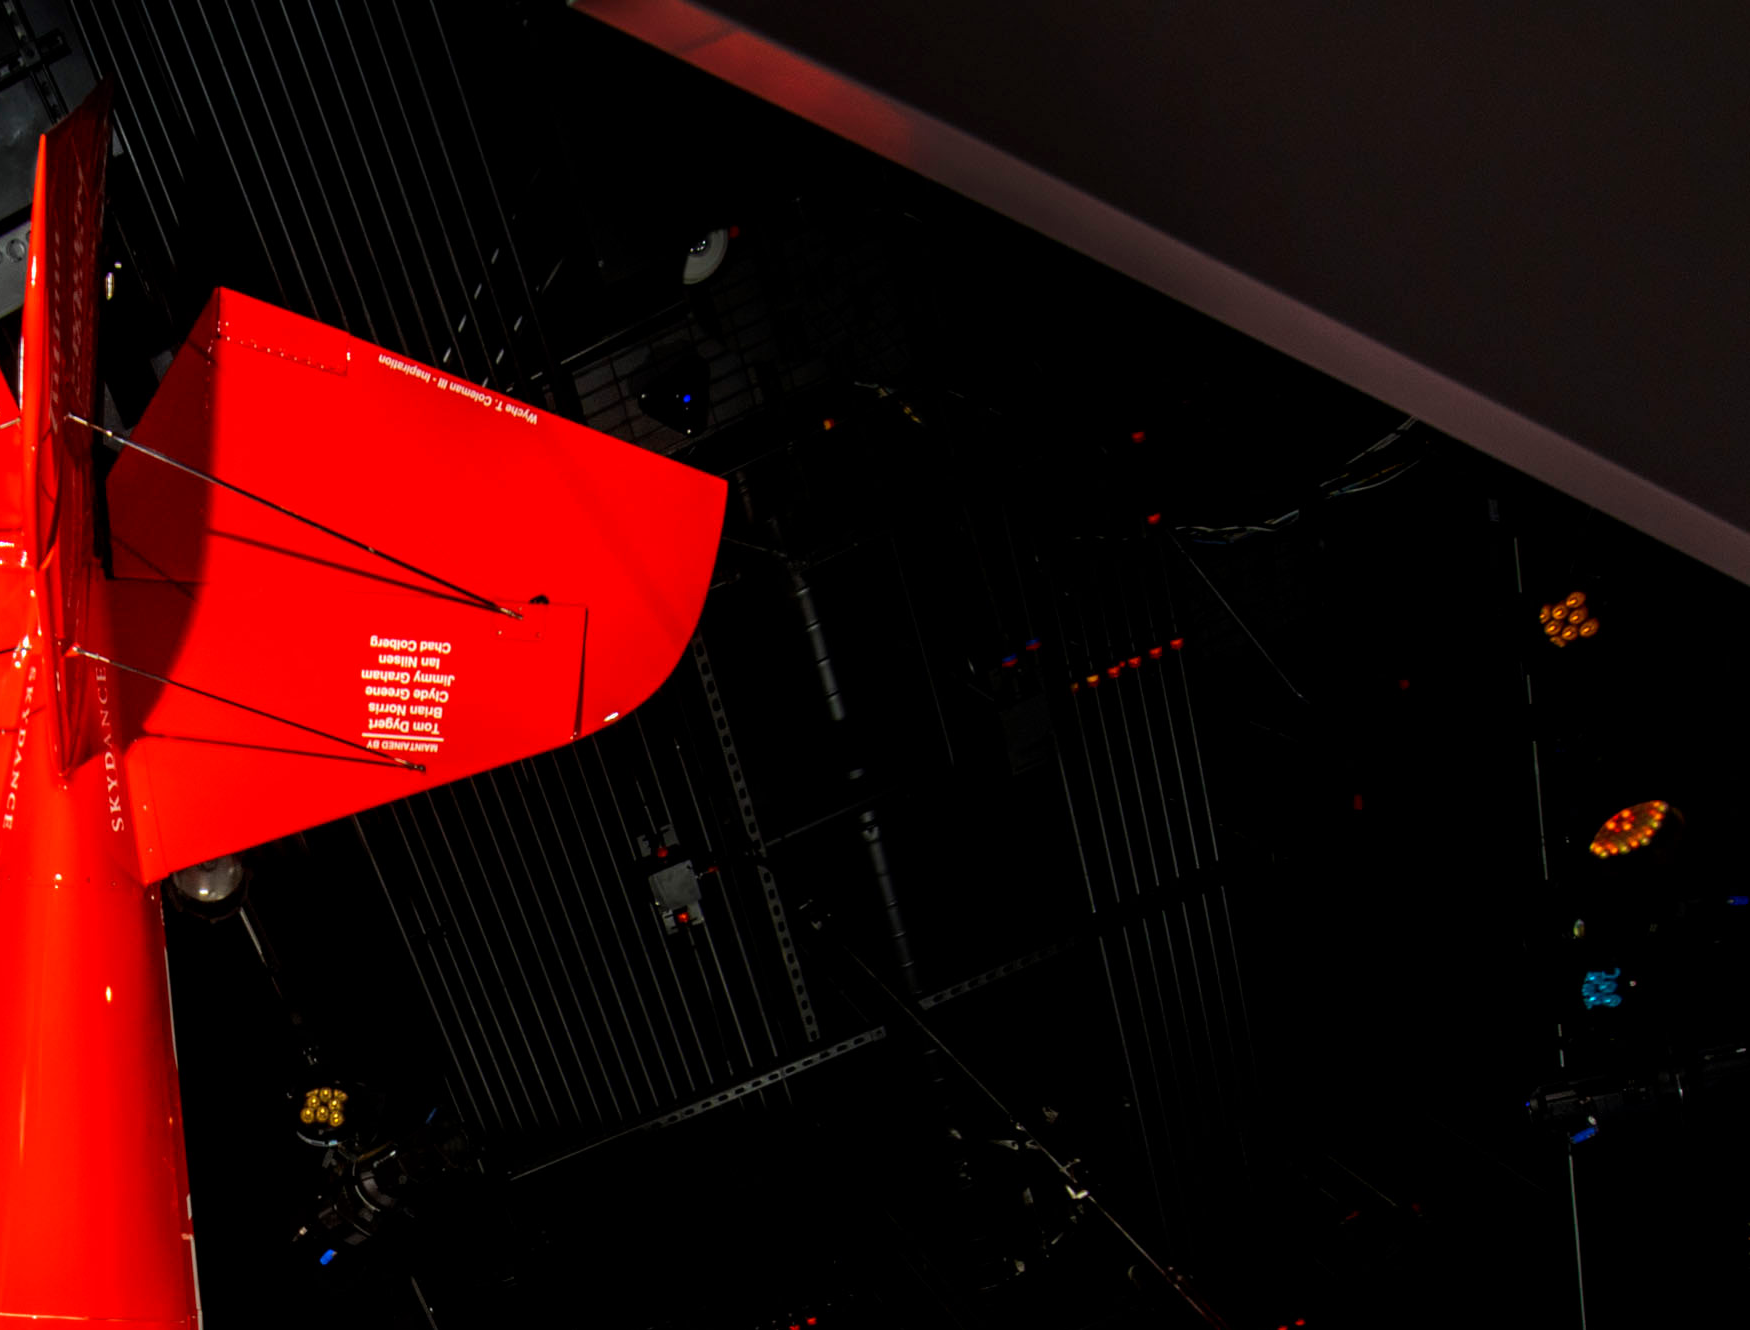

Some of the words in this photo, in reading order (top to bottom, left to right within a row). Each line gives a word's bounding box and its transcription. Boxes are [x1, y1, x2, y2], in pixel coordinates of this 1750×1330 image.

[378, 353, 431, 383] Inspiration
[450, 382, 492, 407] Coleman
[495, 399, 504, 412] T.
[505, 404, 538, 425] Wyche
[370, 634, 417, 653] Colberg
[420, 640, 451, 655] Chad
[378, 653, 418, 669] Nilsen
[421, 656, 440, 670] Ian
[361, 668, 410, 685] Graham
[413, 669, 455, 688] Jimmy
[365, 685, 410, 701] Greene
[413, 687, 449, 704] Clyde
[368, 701, 407, 717] Norris
[410, 704, 443, 720] Brian
[368, 716, 410, 734] Dygert
[412, 721, 440, 736] Tom
[95, 666, 125, 832] SKYDANCE
[366, 738, 380, 750] BY
[382, 740, 438, 753] MAINTAINED
